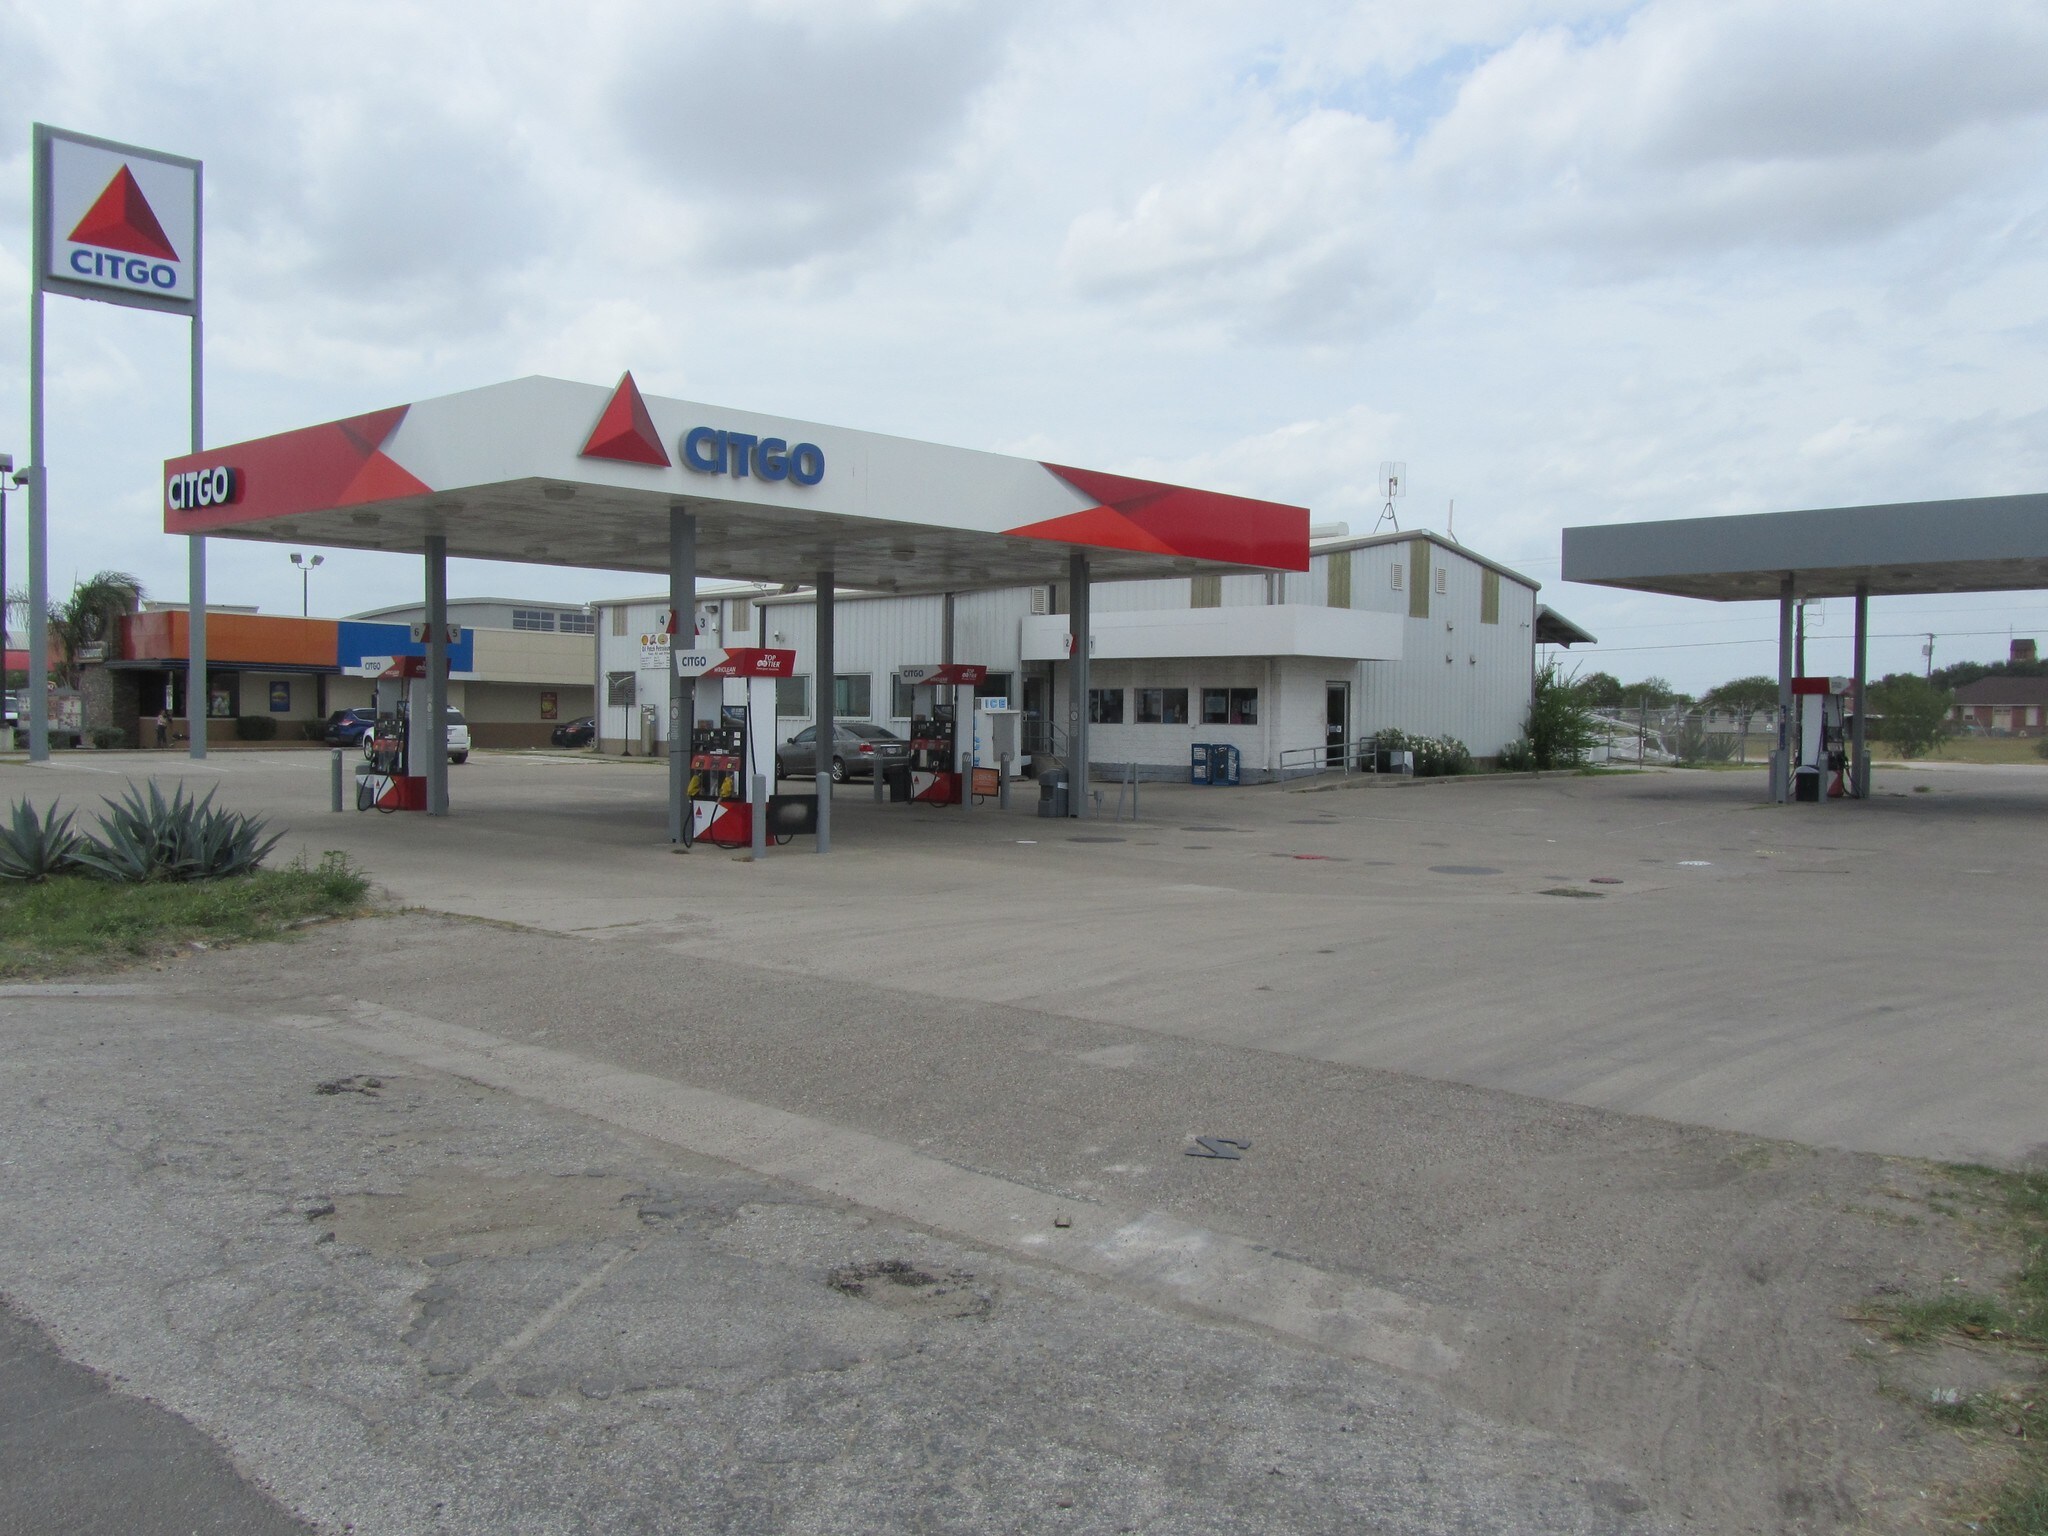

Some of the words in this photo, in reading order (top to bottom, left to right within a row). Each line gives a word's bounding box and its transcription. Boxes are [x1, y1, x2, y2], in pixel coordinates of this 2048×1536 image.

[70, 250, 177, 289] CITGO
[684, 426, 825, 486] CITGO
[168, 465, 230, 510] CITGO
[660, 616, 665, 625] 4
[700, 617, 706, 628] 3
[414, 627, 420, 637] 6
[452, 629, 458, 638] 5
[1065, 638, 1070, 648] 2
[364, 662, 381, 670] CITGO
[681, 656, 707, 667] CITGO
[768, 660, 781, 668] TIER
[903, 669, 924, 678] CITGO
[984, 698, 1006, 709] ICE
